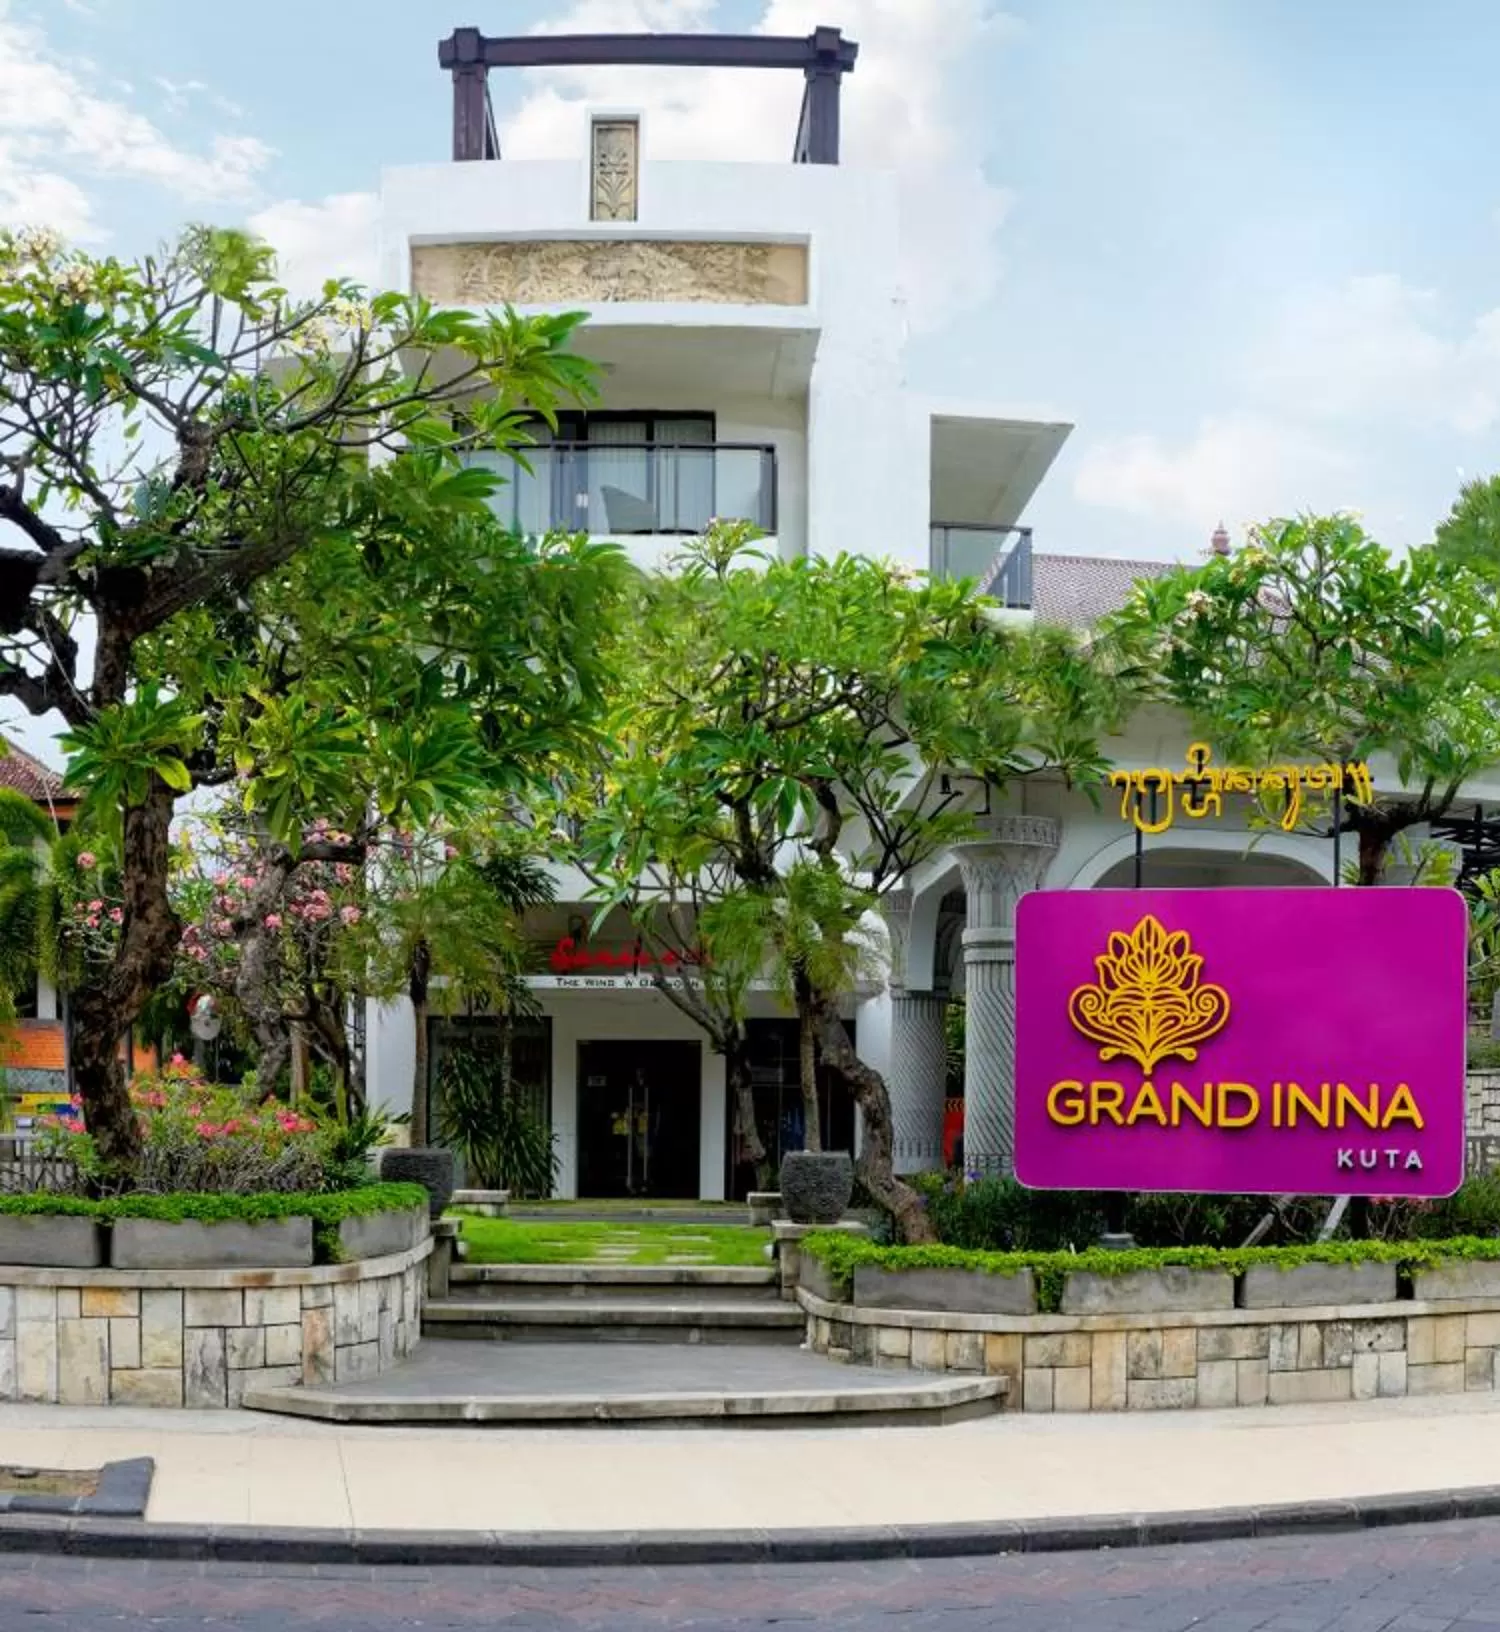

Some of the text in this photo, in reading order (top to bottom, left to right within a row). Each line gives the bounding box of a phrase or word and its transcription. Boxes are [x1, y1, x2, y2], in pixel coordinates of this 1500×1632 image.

[1046, 1079, 1425, 1129] GRAND INNA
[1336, 1148, 1423, 1170] KUTA
